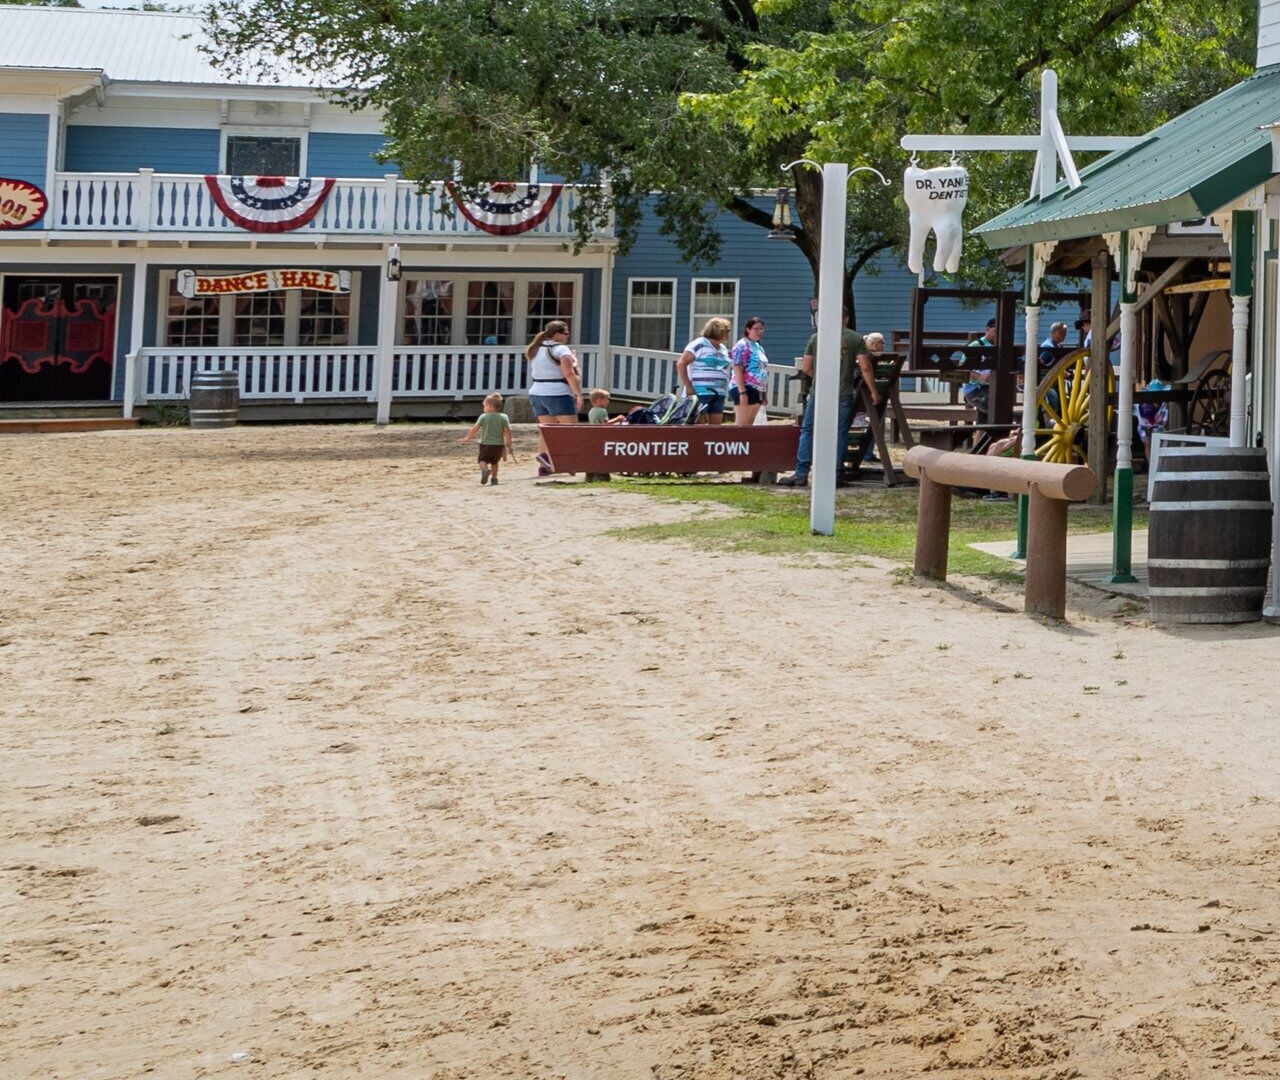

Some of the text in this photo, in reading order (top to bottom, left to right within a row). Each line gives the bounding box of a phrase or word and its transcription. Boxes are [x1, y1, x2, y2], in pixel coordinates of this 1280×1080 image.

[916, 179, 936, 190] DR.
[196, 270, 337, 293] DANCE HALL
[604, 441, 750, 456] FRONTIER TOWN
